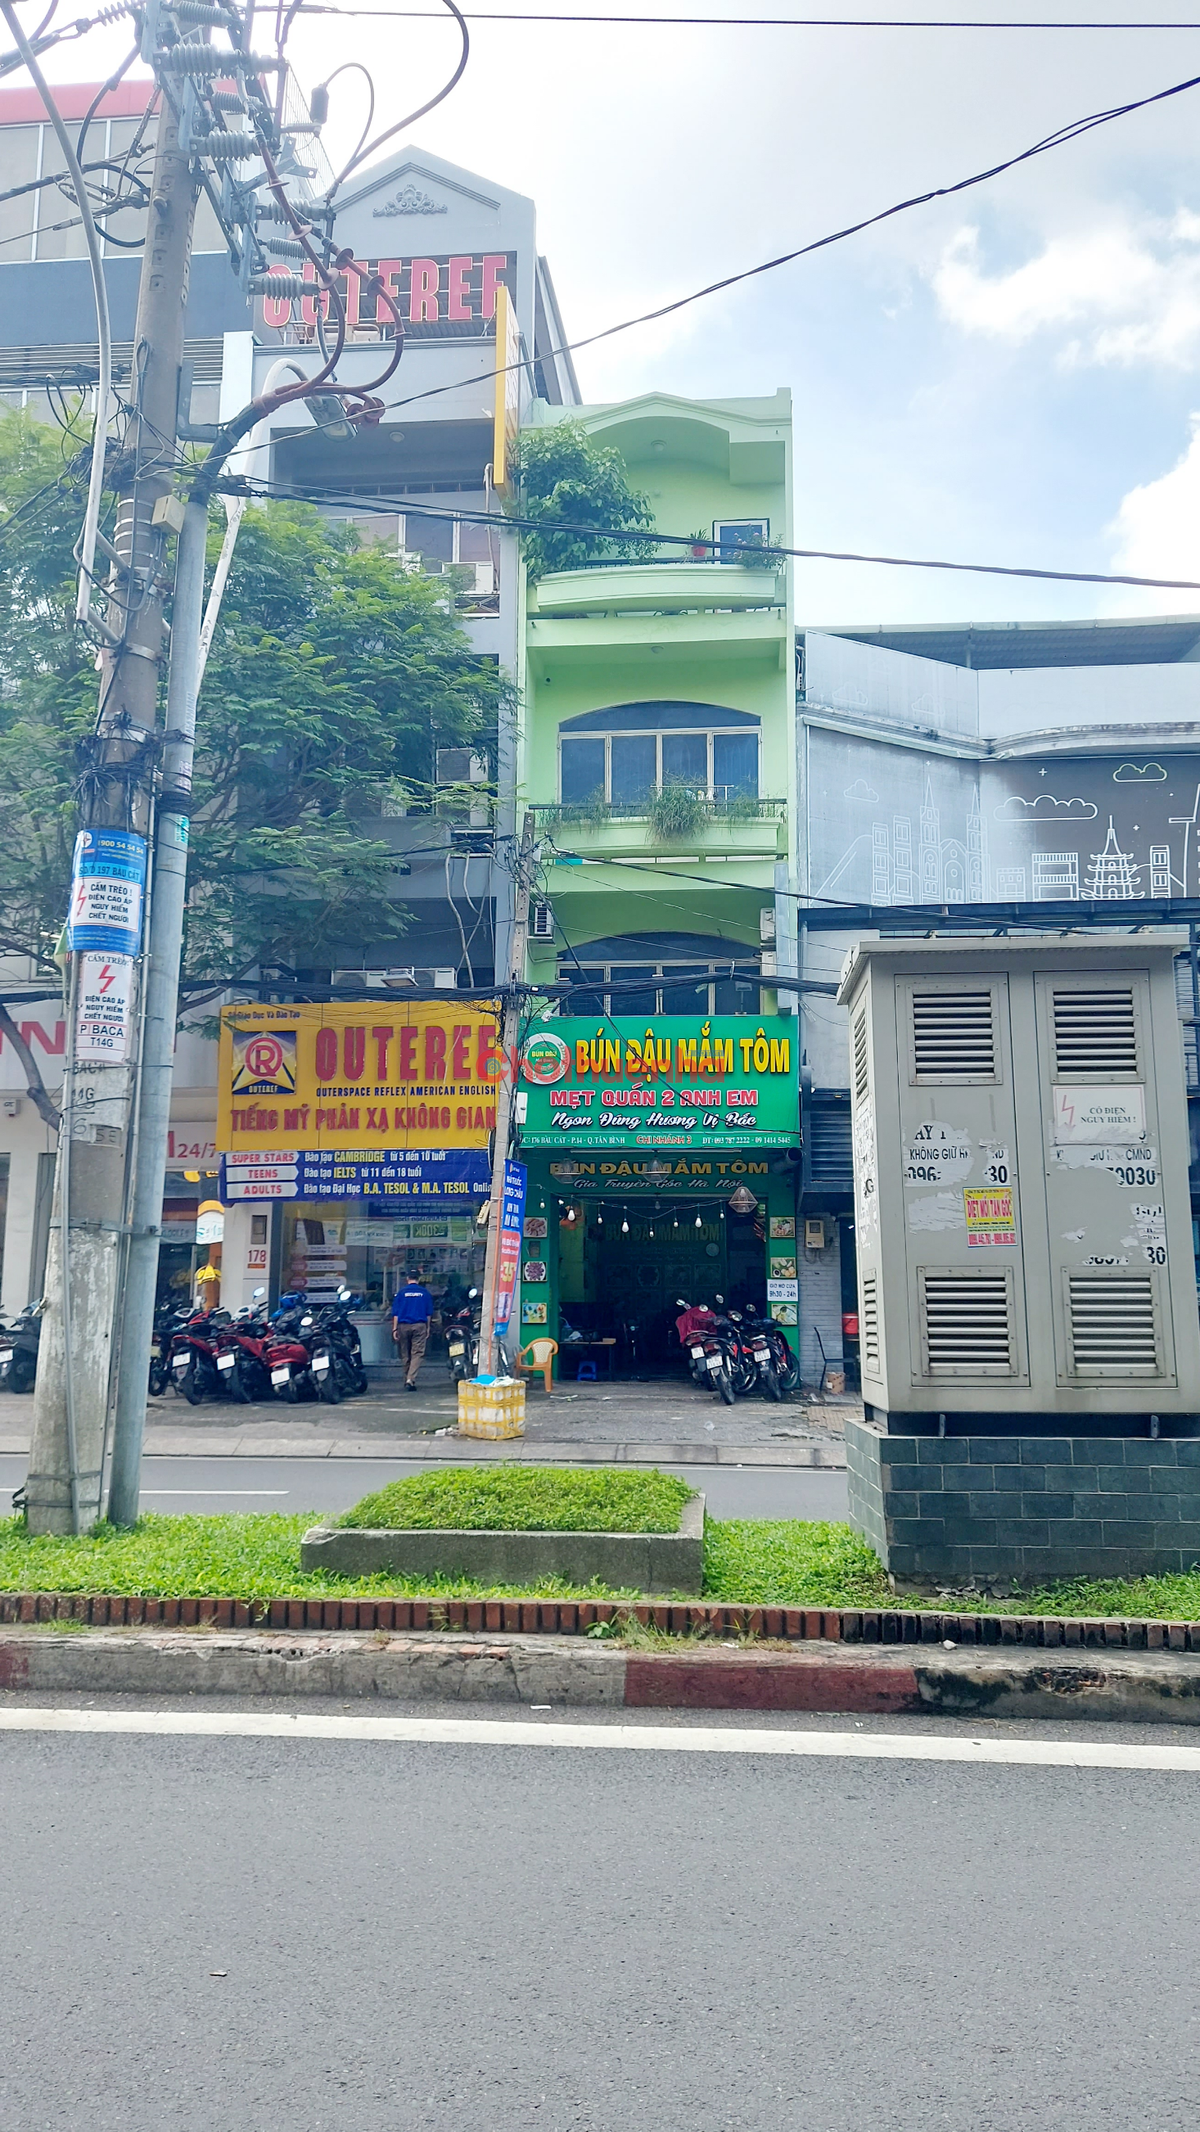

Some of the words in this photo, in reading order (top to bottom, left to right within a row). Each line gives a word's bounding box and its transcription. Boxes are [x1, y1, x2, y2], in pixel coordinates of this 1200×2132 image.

[116, 841, 126, 849] 54
[126, 843, 136, 851] 54
[97, 866, 111, 875] 197
[90, 880, 107, 893] CẤM
[106, 895, 122, 903] CAO
[91, 903, 110, 911] NGUY
[88, 911, 106, 920] CHẾT
[102, 996, 117, 1004] CAO
[80, 1025, 87, 1034] P
[92, 1025, 124, 1037] BACA
[90, 1037, 114, 1047] T14G
[315, 1025, 496, 1081] OUTEREF
[576, 1028, 620, 1073] BÚN
[626, 1028, 671, 1082] ĐẬU
[678, 1021, 734, 1073] MẮM
[739, 1027, 790, 1073] TÔM
[316, 1087, 371, 1097] OUTERSPACE
[374, 1086, 406, 1096] REFLEX
[410, 1086, 456, 1096] AMERICAN
[459, 1085, 496, 1095] ENGLISH
[550, 1090, 595, 1109] MẸT
[602, 1083, 656, 1107] QUÁN
[661, 1090, 675, 1106] 2
[680, 1089, 721, 1106] ANH
[727, 1089, 758, 1106] EM
[1089, 1106, 1103, 1115] CÓ
[1104, 1107, 1126, 1116] ĐIỆN
[230, 1102, 279, 1131] TIẾNG
[283, 1103, 311, 1131] MỸ
[315, 1102, 361, 1131] PHẢN
[366, 1107, 389, 1134] XẠ
[394, 1102, 451, 1130] KHÔNG
[456, 1106, 496, 1129] GIAN
[551, 1112, 593, 1129] Ngon
[599, 1112, 641, 1129] Đúng
[645, 1112, 698, 1129] Hương
[702, 1112, 720, 1128] Vị
[725, 1111, 757, 1127] Bắc
[636, 1135, 651, 1144] CHI
[652, 1133, 685, 1144] NHÁNH
[686, 1135, 692, 1144] 3
[231, 1154, 261, 1163] SUPER
[264, 1153, 294, 1162] STARS
[334, 1151, 386, 1162] CAMBRIDGE
[399, 1152, 404, 1161] 5
[421, 1151, 430, 1161] 10
[909, 1146, 939, 1160] KHÔNG
[1125, 1149, 1152, 1160] CMND
[333, 1167, 356, 1178] IELTS
[370, 1168, 379, 1177] 11
[381, 1166, 395, 1177] đến
[397, 1168, 406, 1177] 18
[716, 1159, 769, 1174] TÔM
[248, 1169, 278, 1178] TEENS
[243, 1185, 282, 1195] ADULTS
[363, 1183, 381, 1194] B.A.
[384, 1182, 410, 1194] TESOL
[412, 1183, 419, 1194] &
[421, 1182, 441, 1194] M.A.
[443, 1182, 470, 1193] TESOL
[248, 1249, 266, 1262] 178
